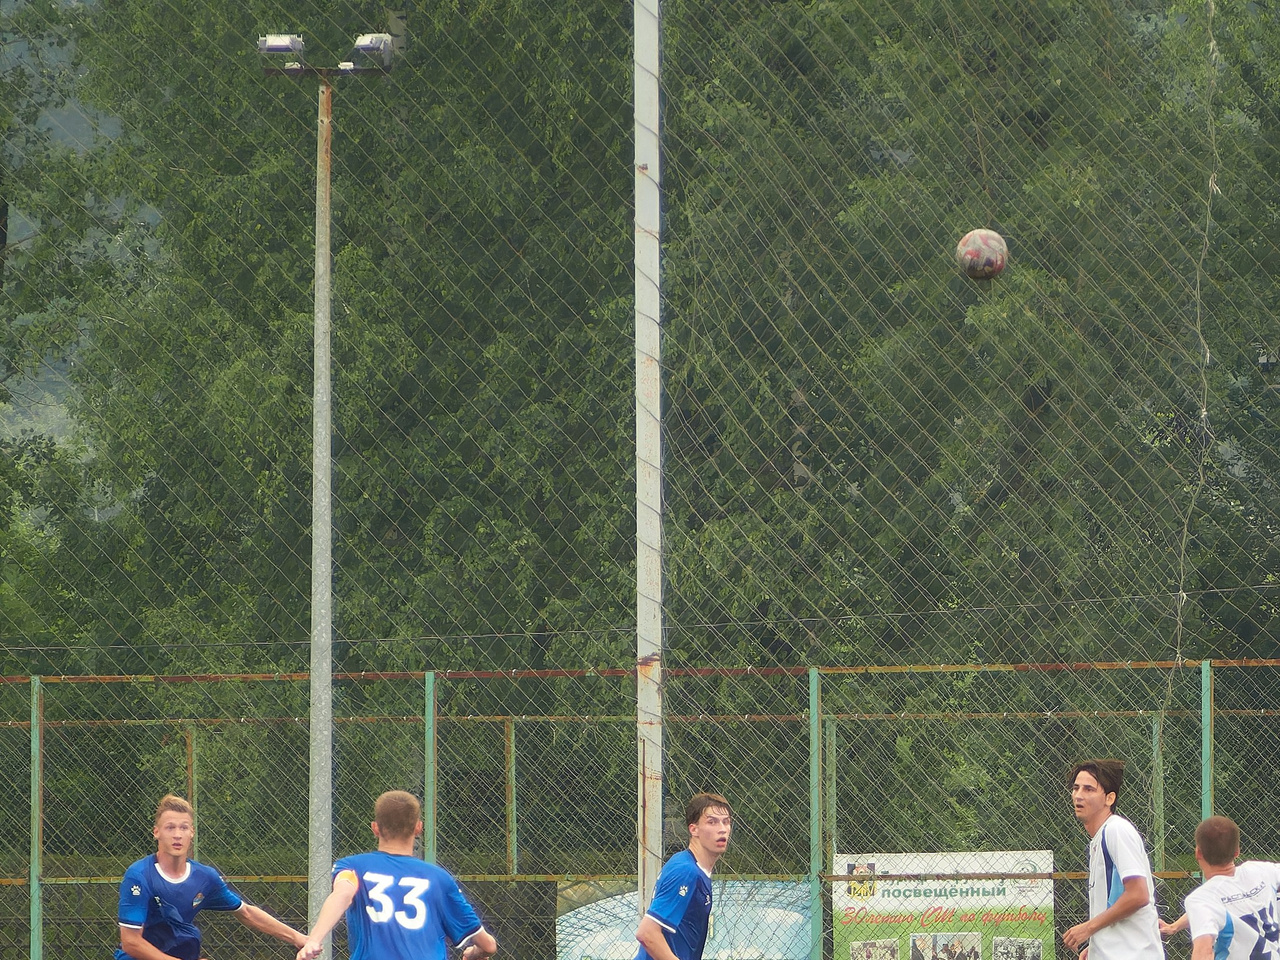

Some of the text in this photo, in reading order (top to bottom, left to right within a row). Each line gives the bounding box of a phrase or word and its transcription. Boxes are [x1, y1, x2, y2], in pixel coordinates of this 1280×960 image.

[363, 872, 430, 930] 33
[881, 885, 1006, 899] посвещённый
[959, 913, 976, 922] по
[981, 905, 1047, 926] футболу
